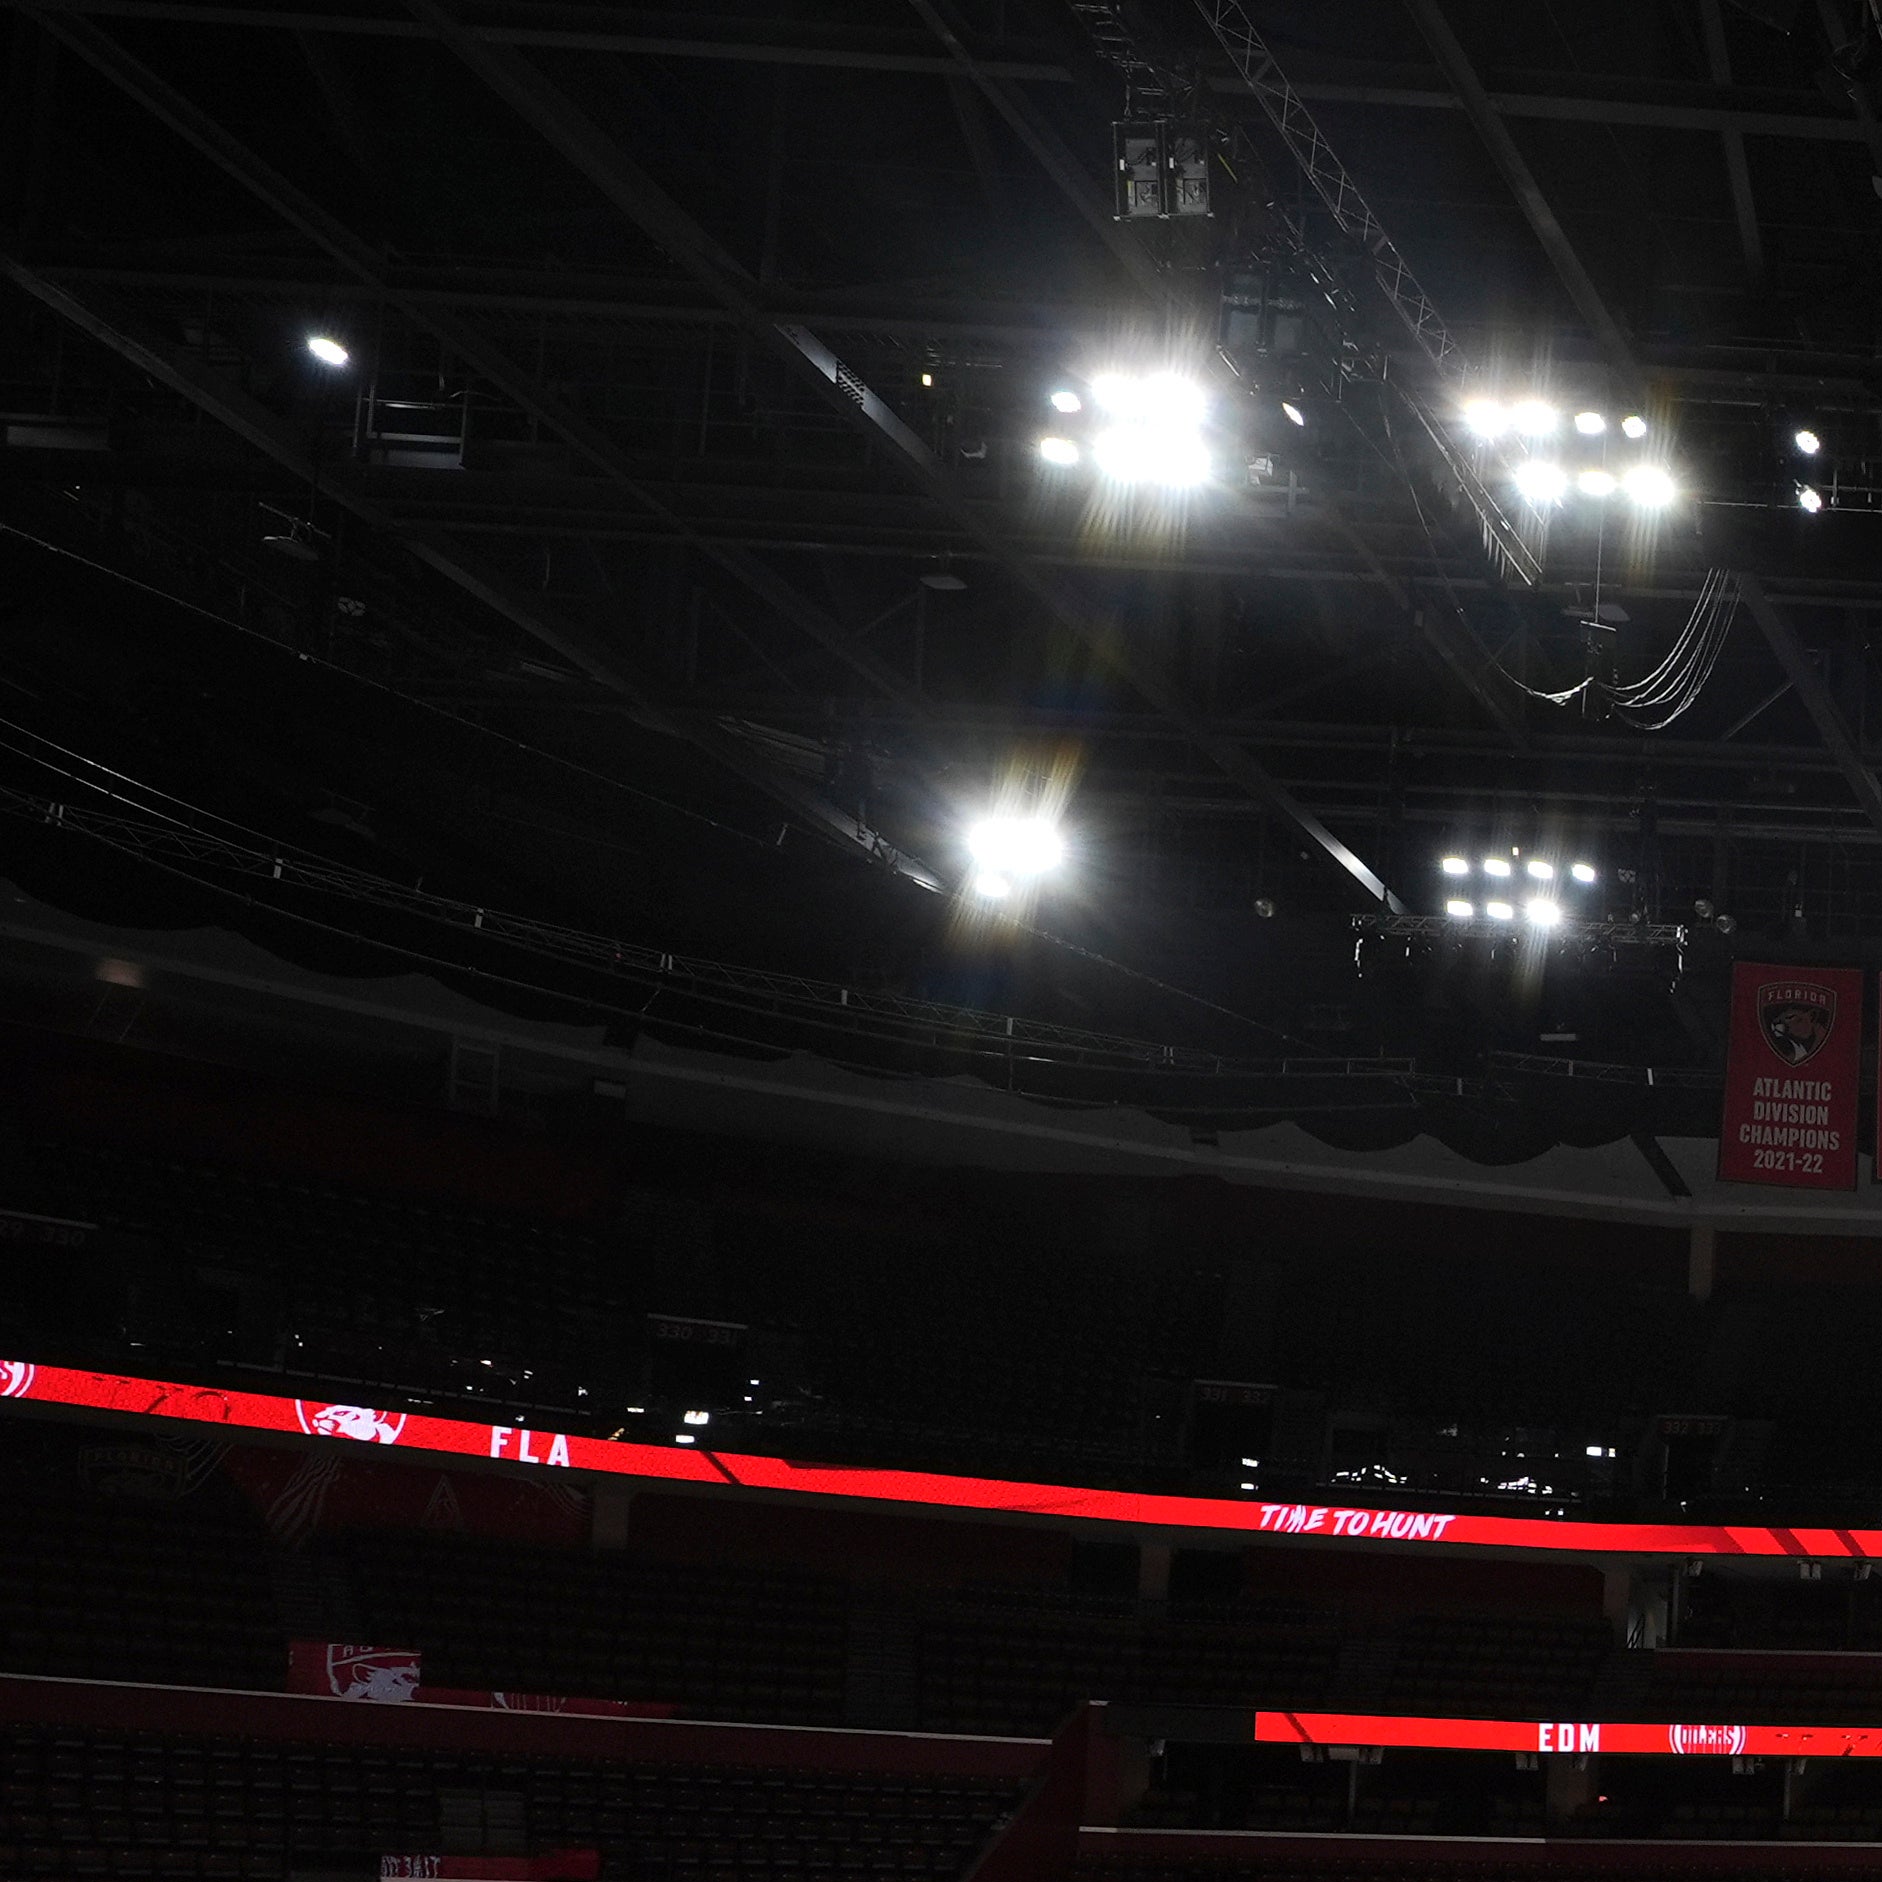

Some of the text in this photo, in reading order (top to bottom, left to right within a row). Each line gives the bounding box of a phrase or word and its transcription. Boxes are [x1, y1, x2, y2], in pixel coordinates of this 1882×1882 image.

[1766, 988, 1827, 1005] FLORIDA
[1753, 1077, 1832, 1102] ATLANTIC
[1753, 1101, 1829, 1126] DIVISION
[1738, 1124, 1840, 1152] CHAMPIONS
[1753, 1149, 1824, 1174] 2021-22
[490, 1425, 571, 1468] FLA
[1332, 1510, 1370, 1536] TO
[1370, 1510, 1456, 1540] HUNT
[1538, 1723, 1600, 1752] EDM
